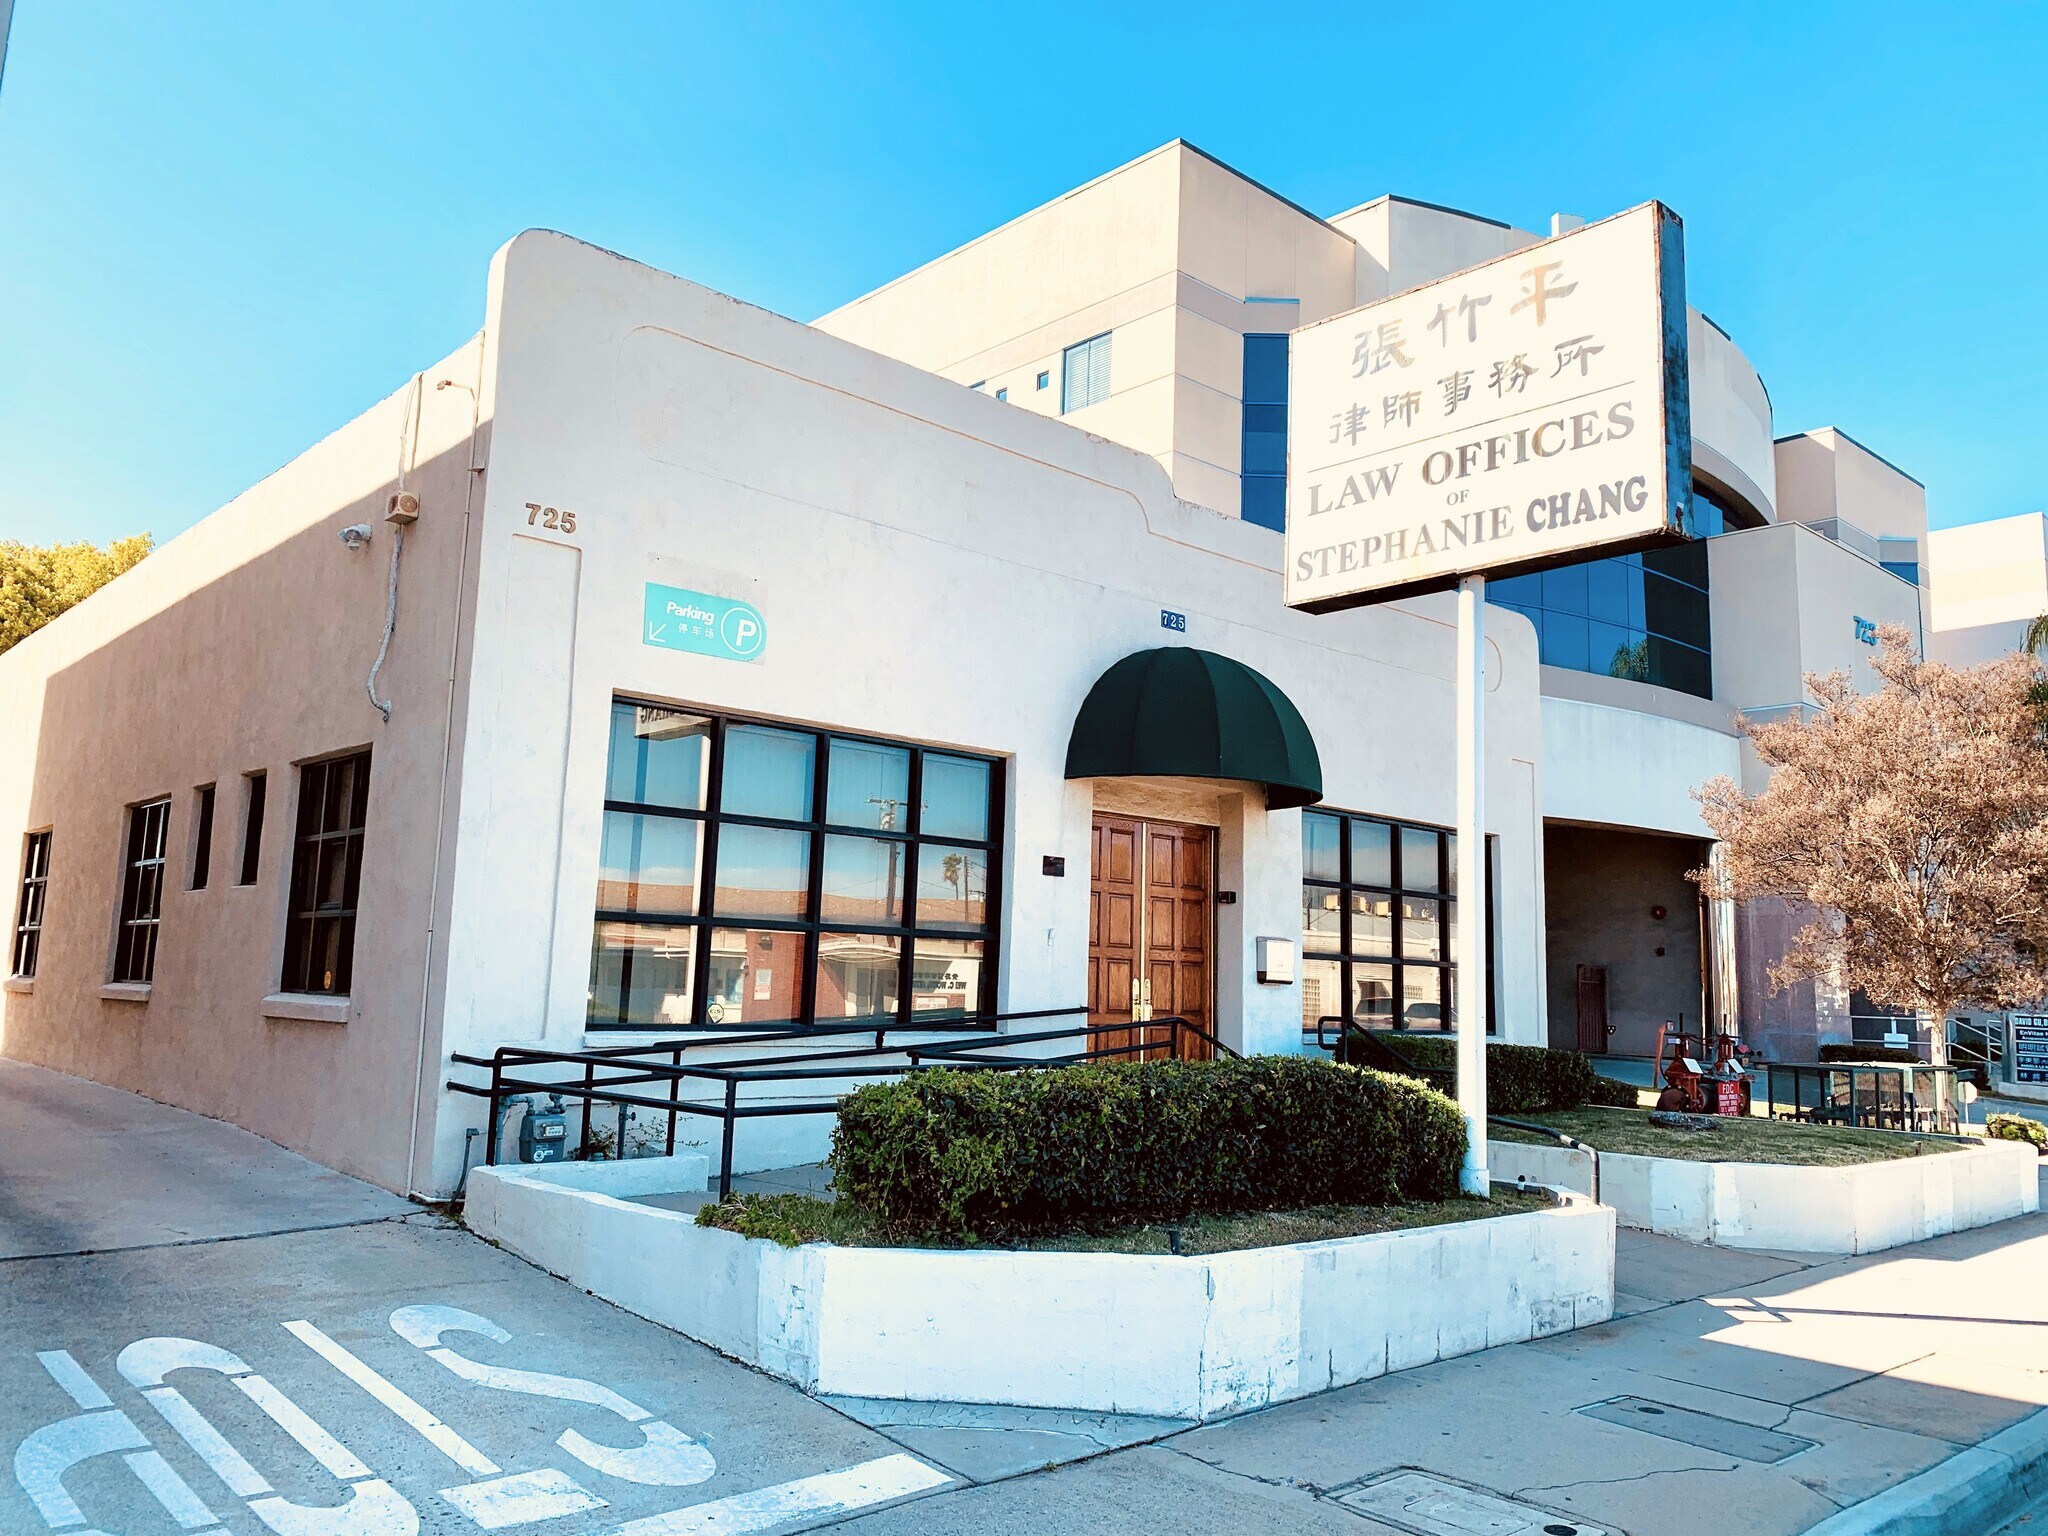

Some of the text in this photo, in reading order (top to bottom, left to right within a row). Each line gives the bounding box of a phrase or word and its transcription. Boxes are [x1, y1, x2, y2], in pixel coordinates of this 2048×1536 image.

[1351, 260, 1579, 379] 張竹平
[1328, 334, 1605, 447] 律師事務所
[1307, 400, 1636, 517] LAW OFFICES
[1446, 487, 1470, 507] OF
[525, 502, 577, 534] 725
[1296, 475, 1649, 583] STEPHANIE CHANG
[666, 600, 715, 626] Parking
[1163, 613, 1184, 629] 725
[678, 623, 714, 640] 停车场
[735, 618, 757, 647] P
[1722, 1083, 1735, 1094] FDC
[14, 1304, 717, 1536] STOP
